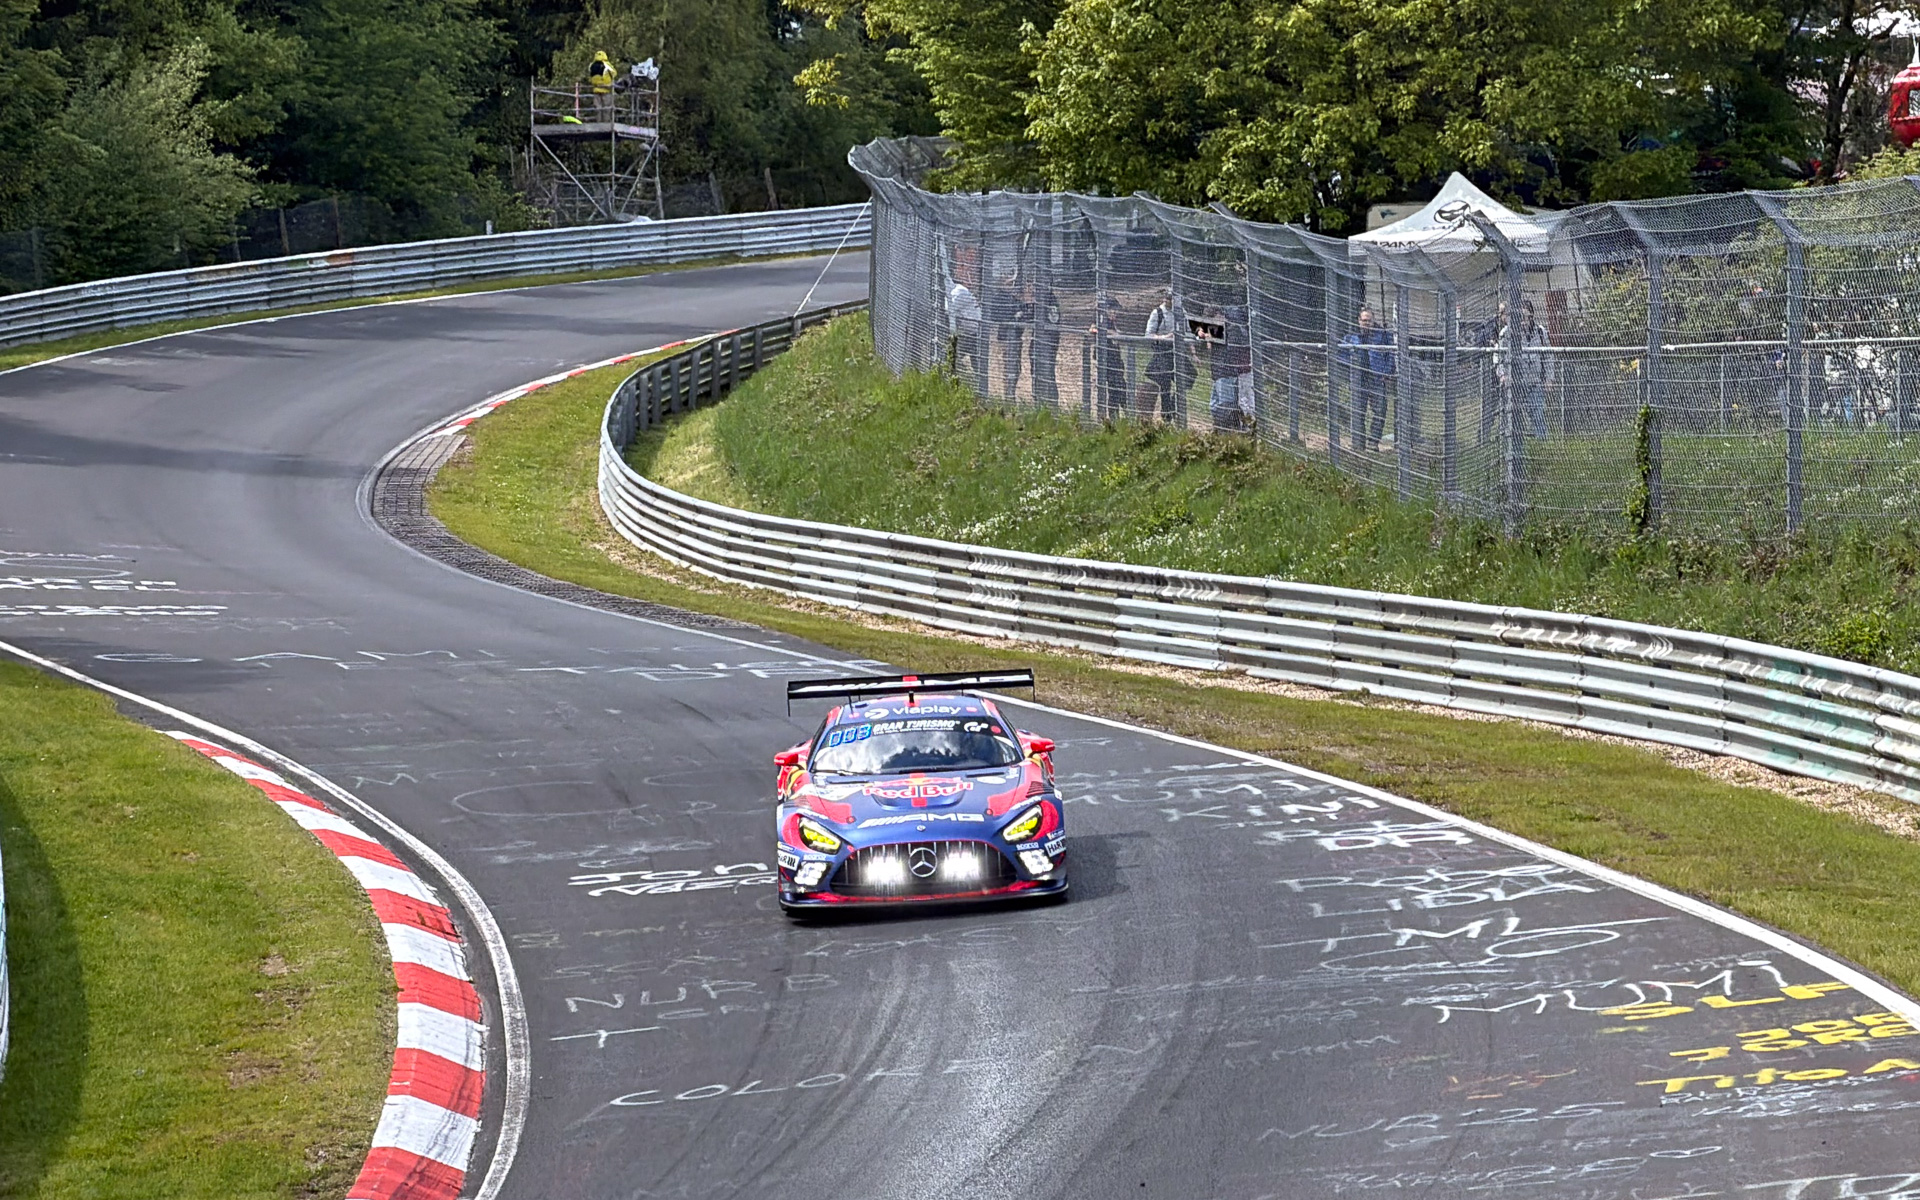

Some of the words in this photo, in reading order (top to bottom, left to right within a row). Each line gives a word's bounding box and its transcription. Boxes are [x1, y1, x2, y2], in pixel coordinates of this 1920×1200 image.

[892, 705, 961, 715] viaplay
[873, 721, 904, 731] GRAN
[862, 784, 919, 799] Red
[920, 781, 973, 796] Bull
